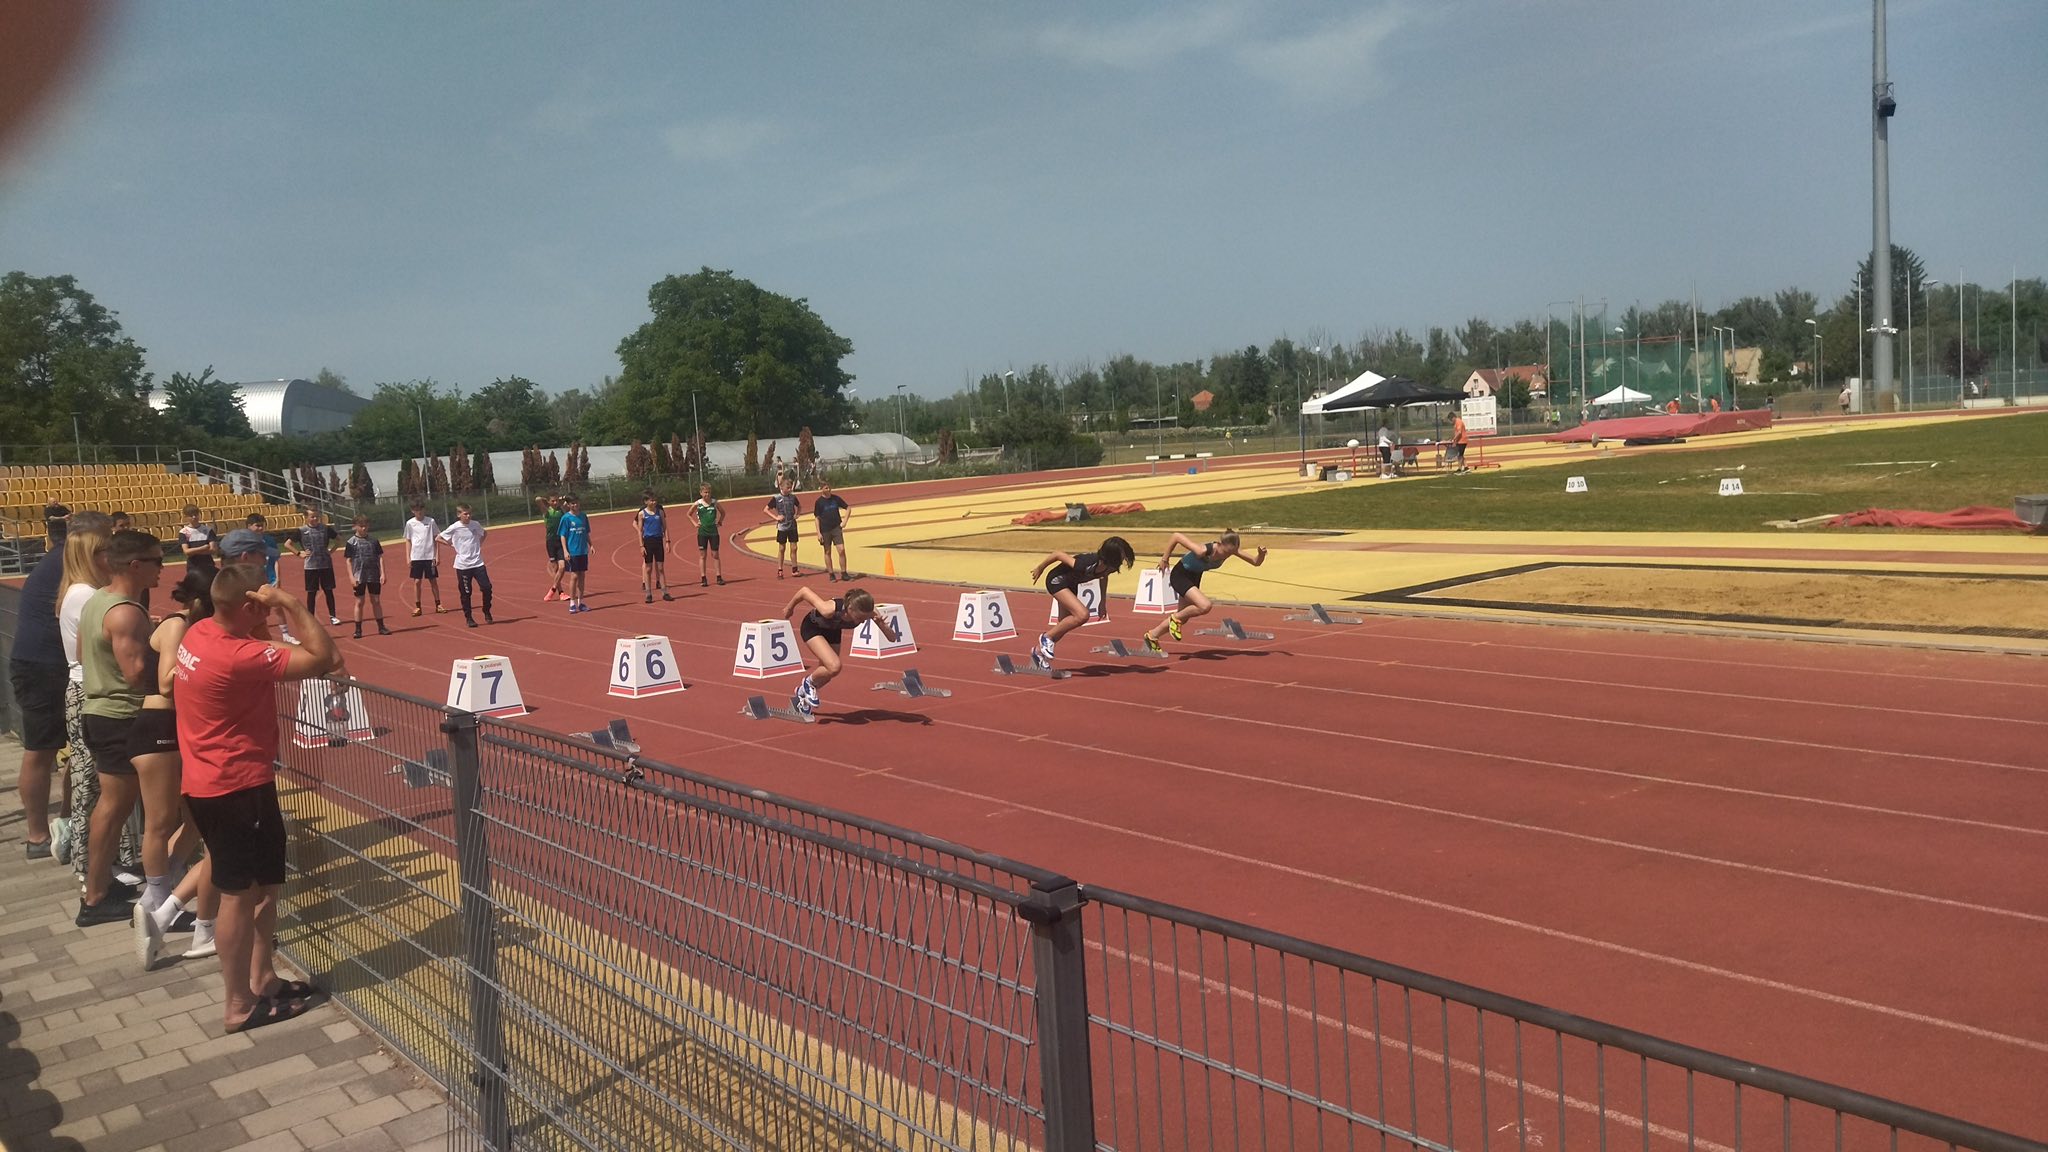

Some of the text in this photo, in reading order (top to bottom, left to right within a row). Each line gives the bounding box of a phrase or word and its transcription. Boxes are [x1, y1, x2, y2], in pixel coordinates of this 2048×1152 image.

[1577, 480, 1584, 488] 10
[1721, 483, 1729, 491] 14
[1732, 482, 1740, 491] 14
[1082, 588, 1097, 613] 2
[1145, 577, 1154, 602] 1
[963, 603, 975, 629] 3
[988, 601, 1003, 628] 3
[859, 617, 872, 645] 4
[889, 615, 903, 643] 4
[176, 643, 201, 671] EDAC
[743, 633, 756, 664] 5
[771, 631, 788, 662] 5
[619, 651, 630, 682] 6
[645, 649, 666, 680] 6
[456, 672, 467, 706] 7
[481, 669, 503, 705] 7
